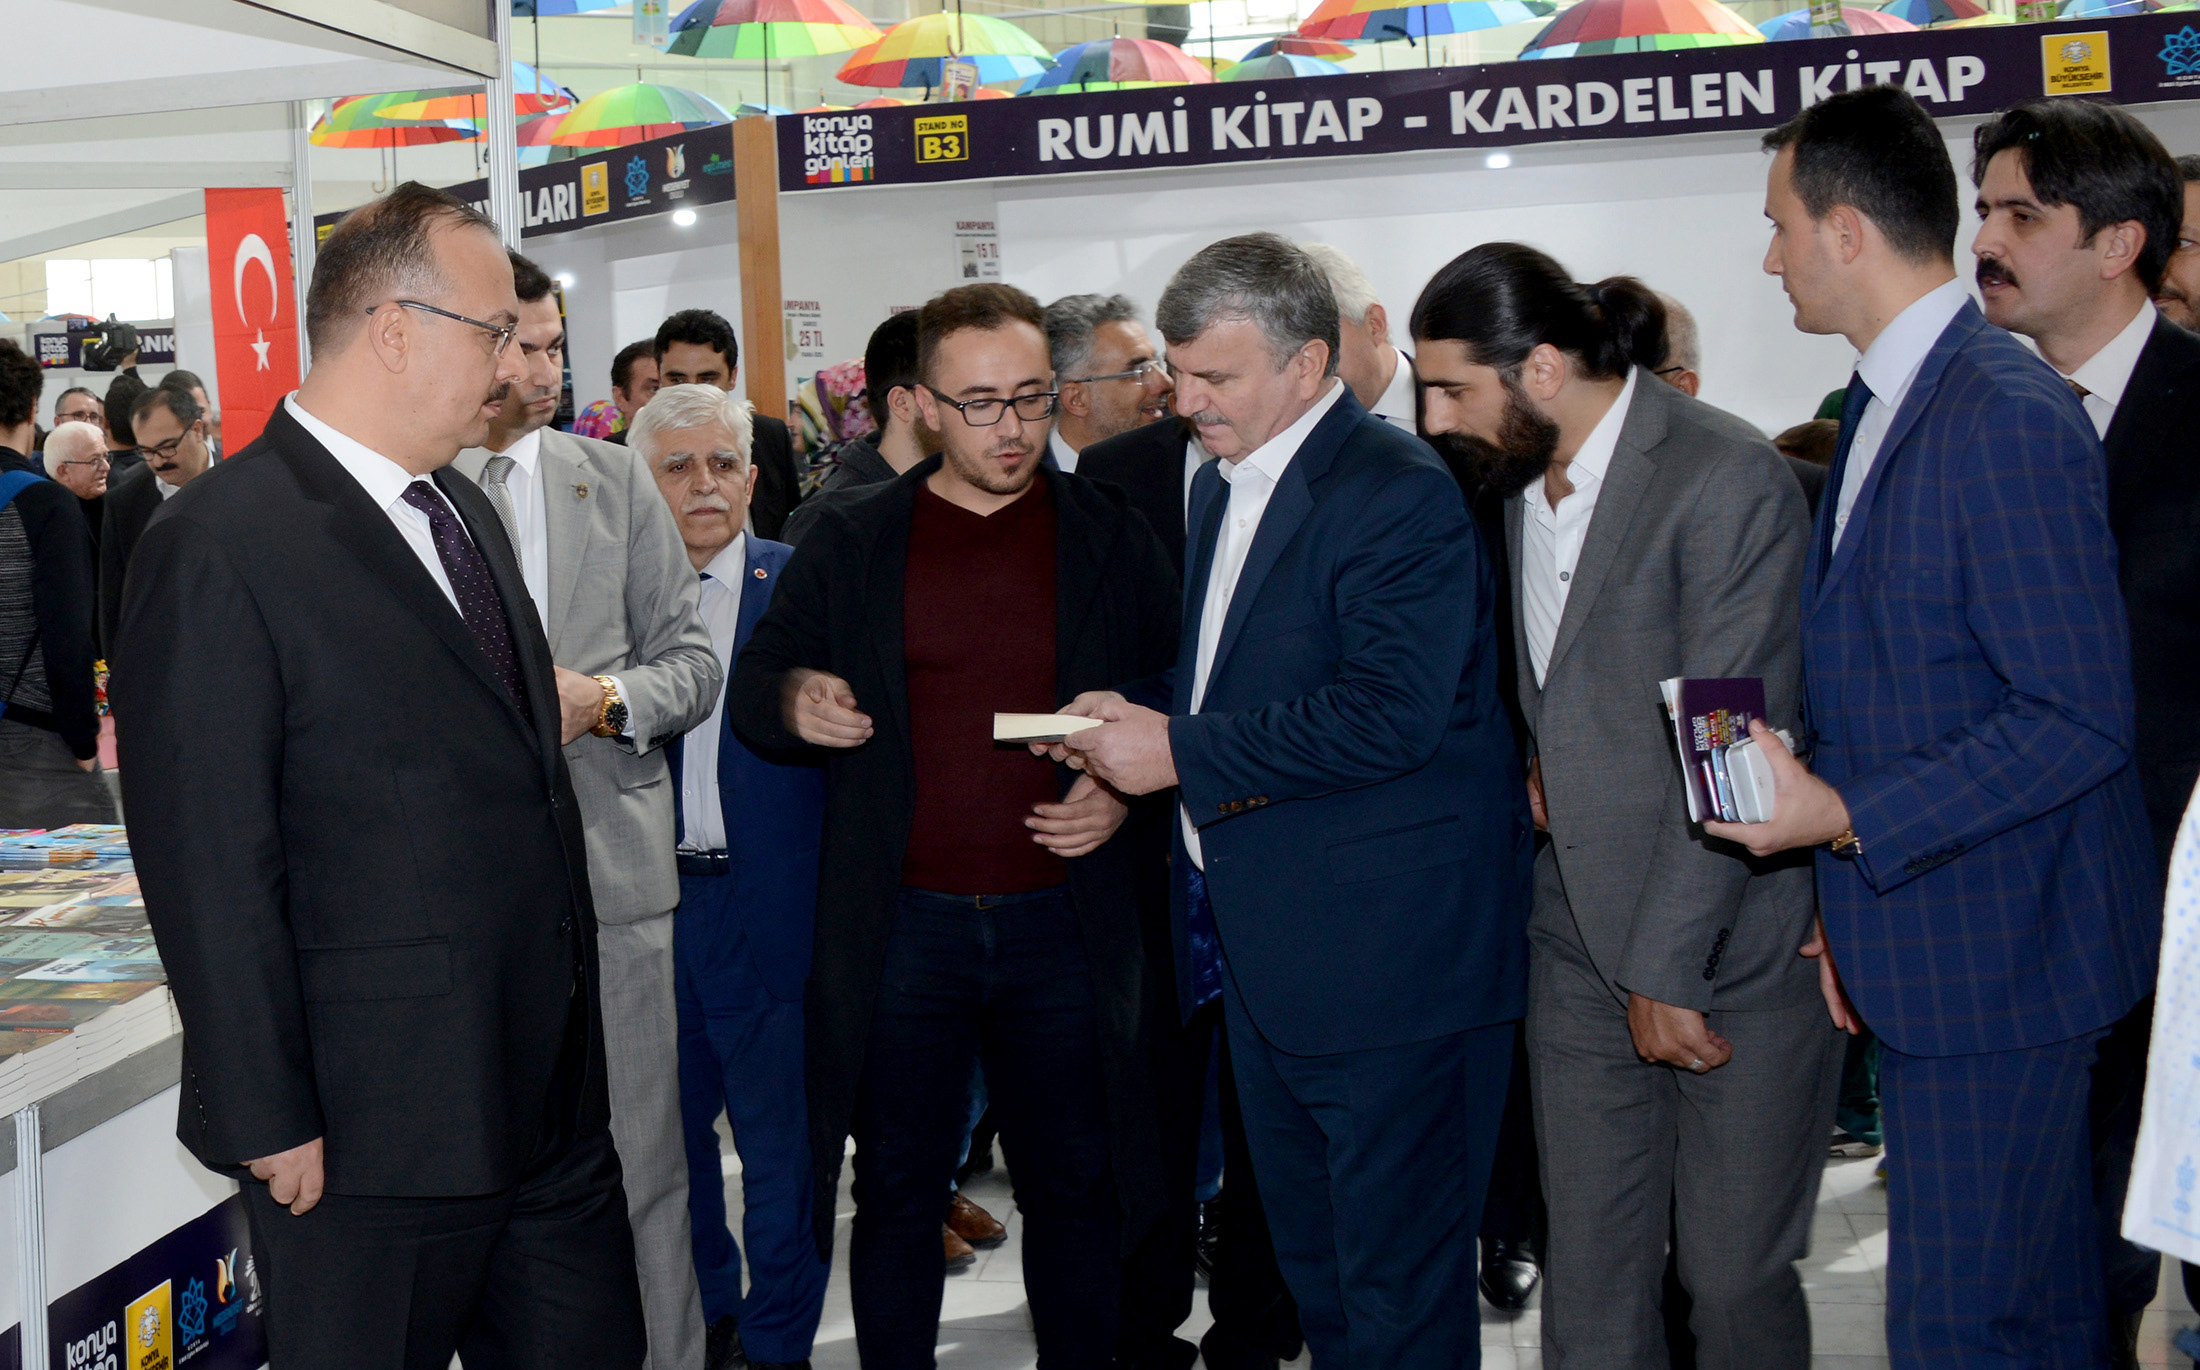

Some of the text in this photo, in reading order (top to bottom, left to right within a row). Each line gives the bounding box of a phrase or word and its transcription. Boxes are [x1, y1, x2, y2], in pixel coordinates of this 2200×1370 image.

[1038, 49, 1986, 161] RUMİ KİTAP - KARDELEN KİTAP
[803, 115, 873, 135] konya
[918, 120, 965, 132] STAND NO
[804, 133, 874, 155] kitap
[923, 135, 961, 160] B3
[805, 152, 874, 176] günleri
[799, 330, 825, 347] 25 TL
[67, 1320, 117, 1370] konya
[141, 1347, 160, 1369] KONYA
